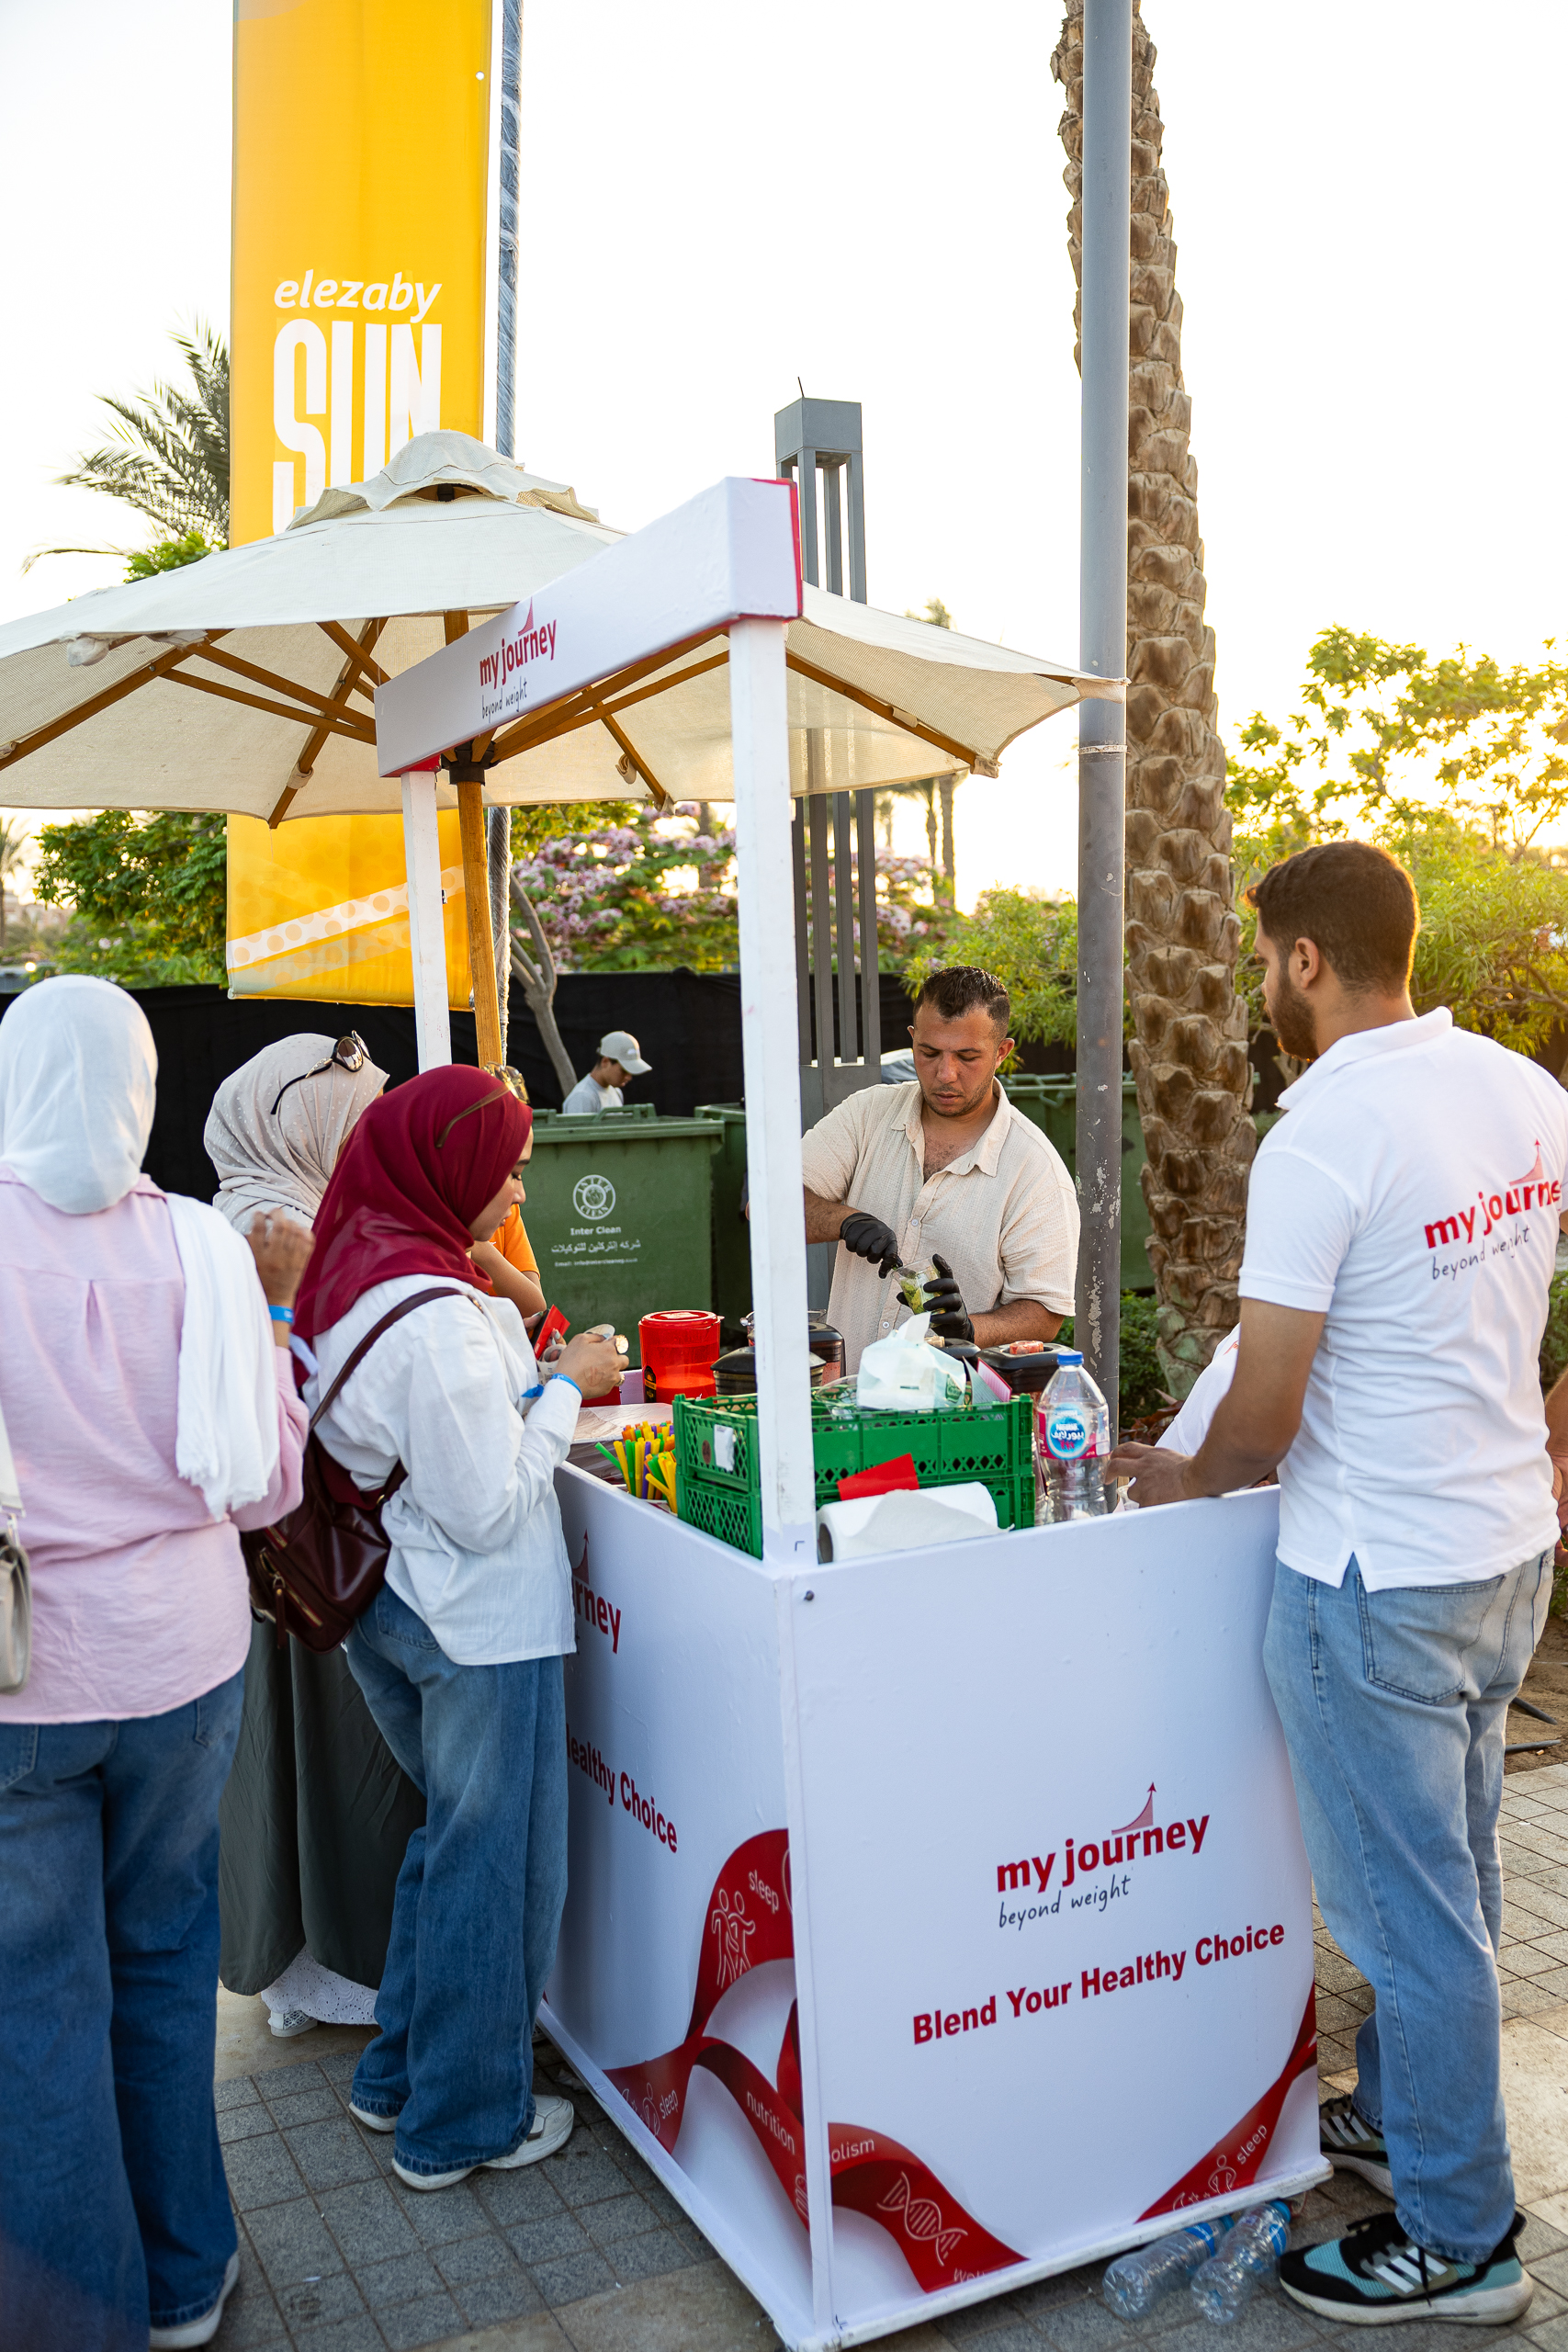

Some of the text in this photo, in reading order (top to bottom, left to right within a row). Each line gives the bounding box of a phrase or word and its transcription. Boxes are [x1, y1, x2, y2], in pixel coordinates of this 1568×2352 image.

[274, 269, 443, 323] elezaby
[273, 318, 442, 536] SUN
[479, 619, 557, 689] my journey
[482, 676, 527, 723] beyond weight
[570, 1227, 621, 1236] Inter Clean
[1424, 1180, 1562, 1249] my journe
[1432, 1223, 1530, 1280] beyond weight
[573, 1577, 621, 1654] rney
[620, 1770, 678, 1854] Choice
[997, 1815, 1210, 1894] my journey
[748, 1870, 780, 1915] sleep
[999, 1873, 1131, 1930] beyond weight
[913, 1924, 1285, 2045] Blend Your Healthy Choice
[659, 2088, 679, 2120] sleep
[746, 2089, 795, 2155] nutrition
[831, 2139, 874, 2162] olism
[1236, 2124, 1268, 2165] sleep
